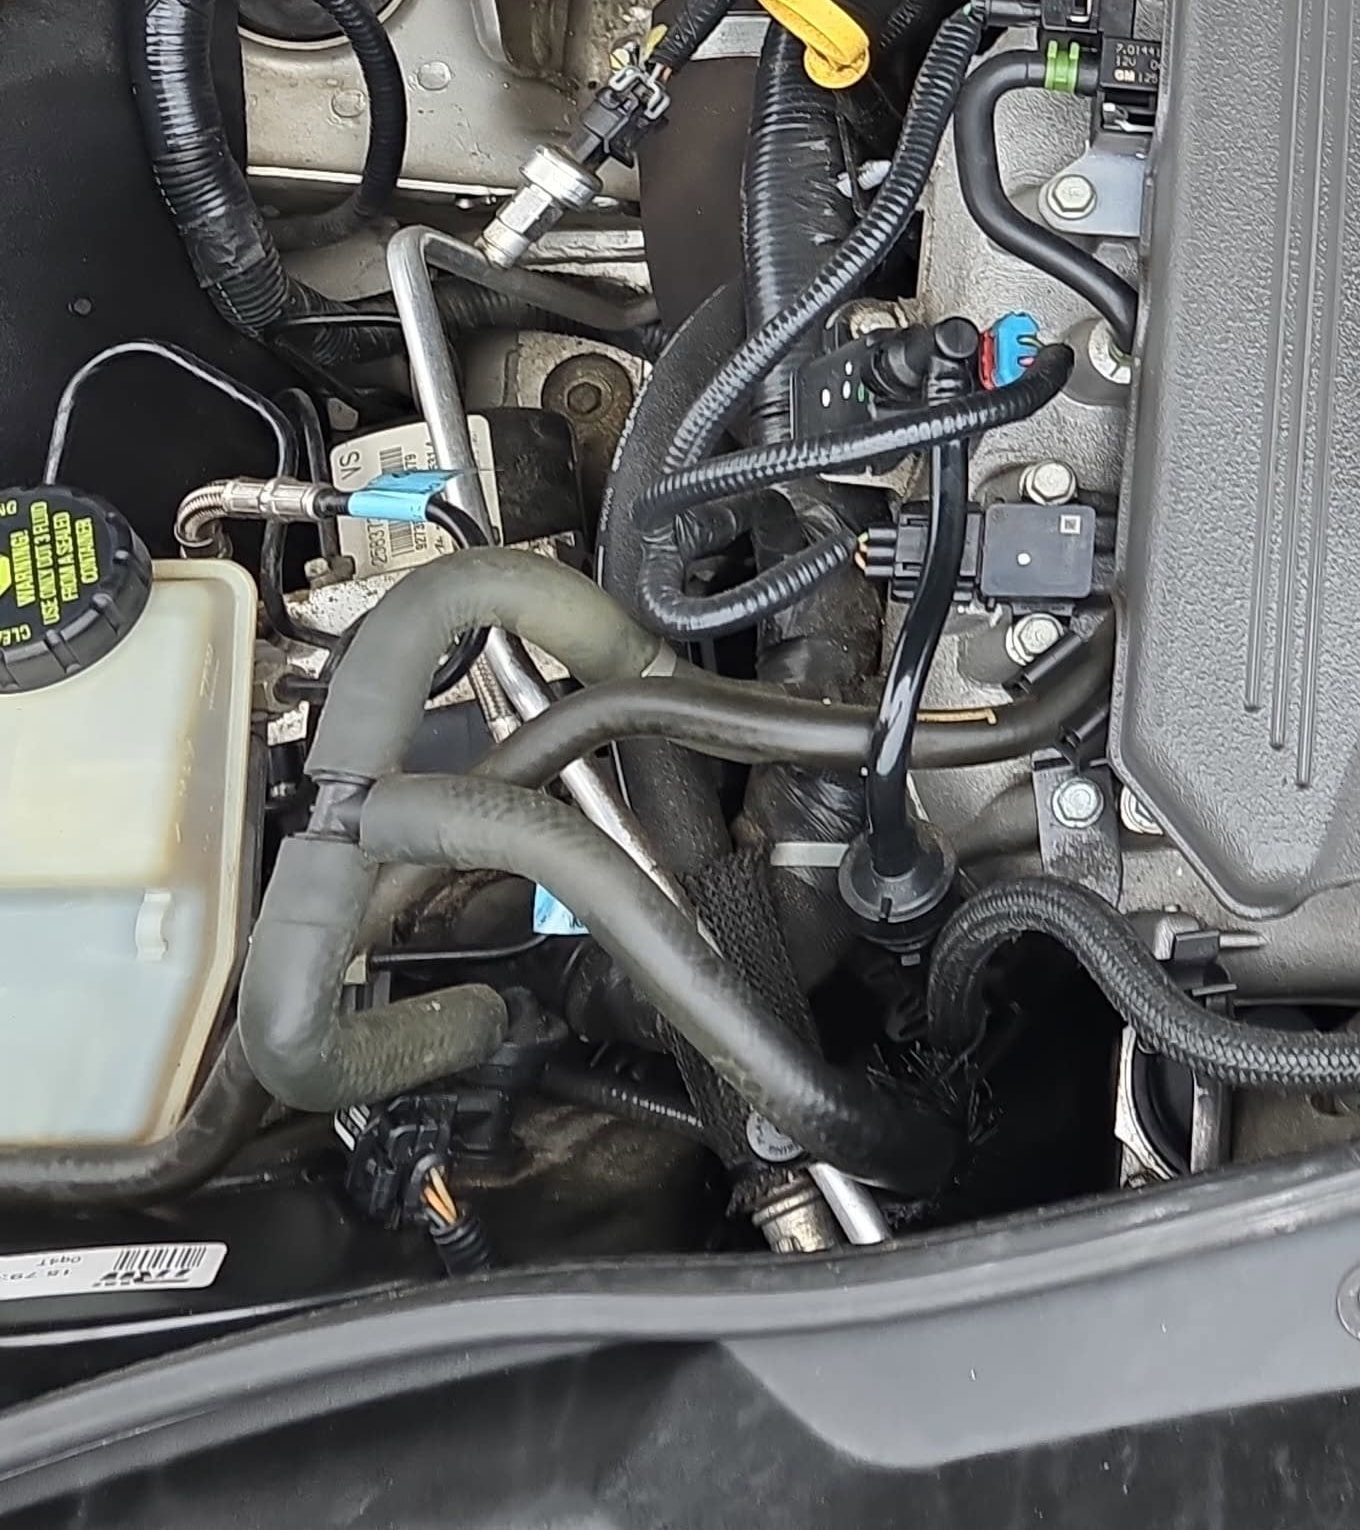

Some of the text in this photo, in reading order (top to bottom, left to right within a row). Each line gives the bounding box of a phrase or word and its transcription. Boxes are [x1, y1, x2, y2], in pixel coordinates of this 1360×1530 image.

[1113, 68, 1136, 82] GM
[339, 450, 362, 481] VS
[10, 529, 36, 608] WARNING!
[30, 501, 60, 626] USE ONLY DOT 3 FLUID
[53, 511, 79, 602] FROM A SEALED
[75, 517, 99, 584] CONTAINER
